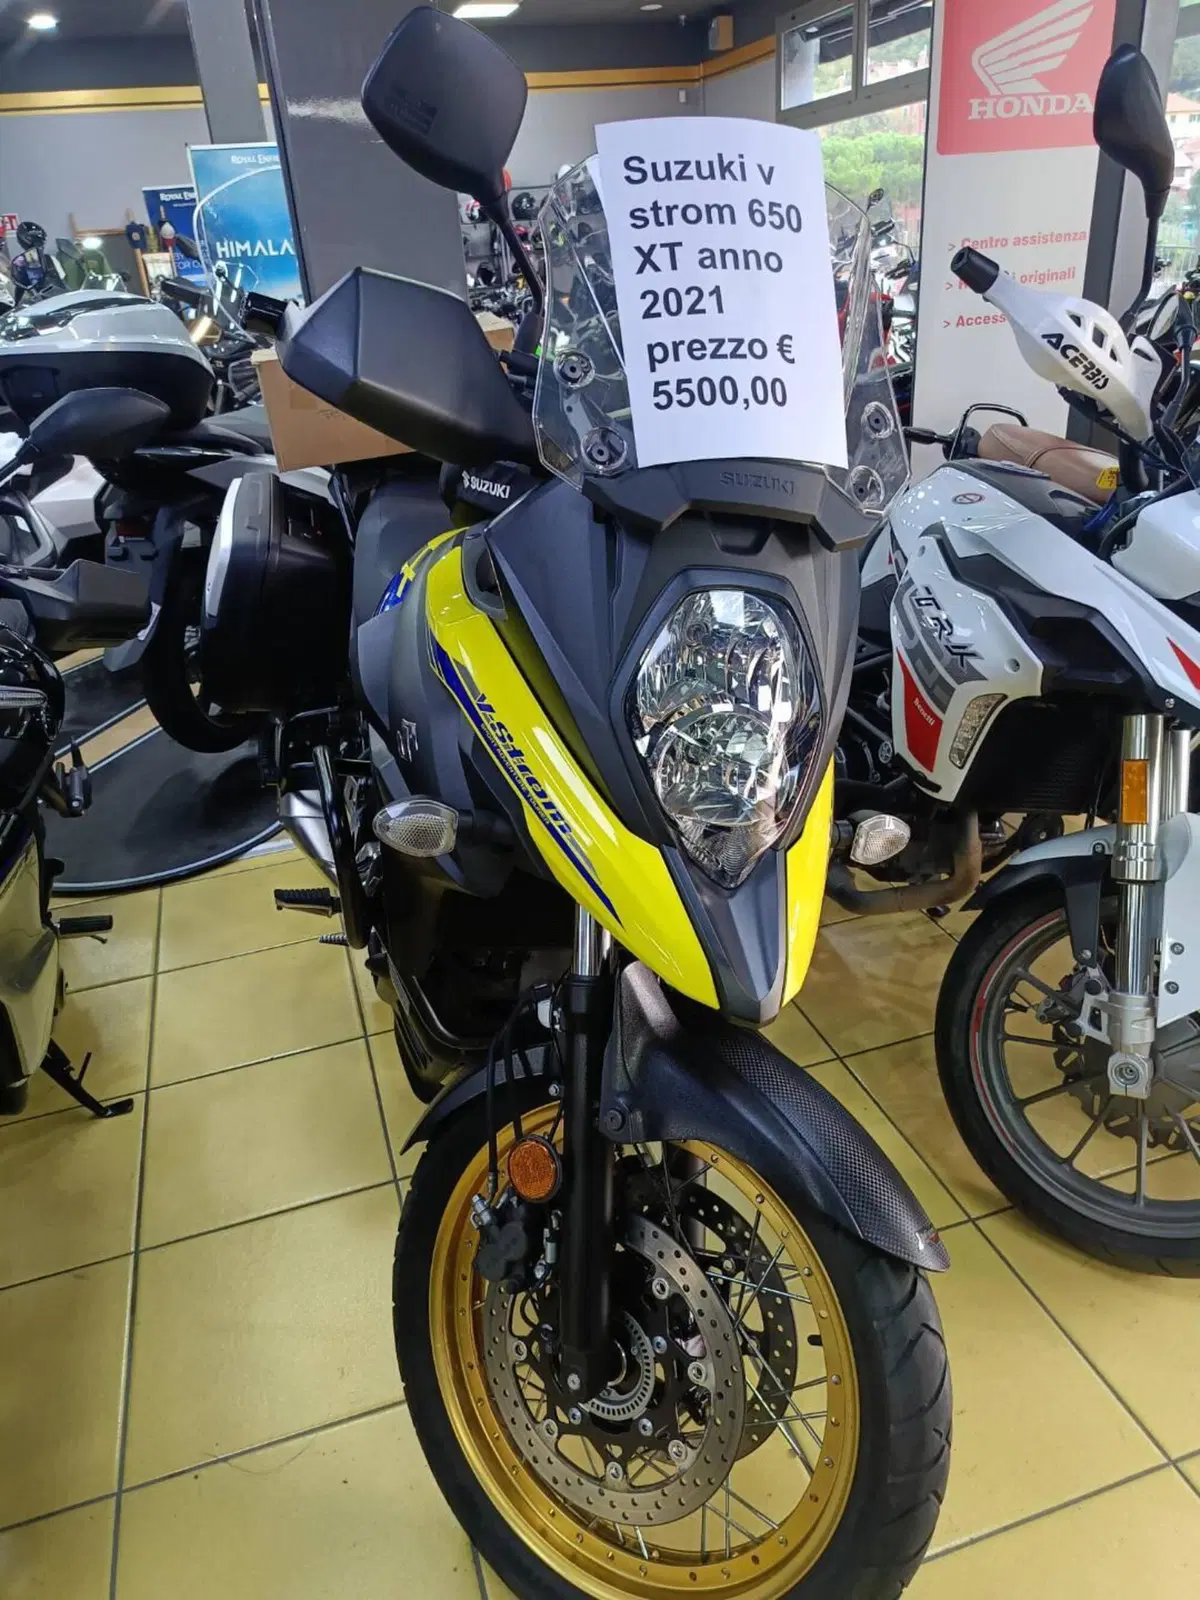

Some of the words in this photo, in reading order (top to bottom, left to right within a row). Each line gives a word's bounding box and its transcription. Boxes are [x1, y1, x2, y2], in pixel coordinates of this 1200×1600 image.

[968, 93, 1093, 120] HONDA
[623, 153, 747, 185] Suzuki
[756, 163, 775, 186] v
[629, 200, 736, 229] strom
[748, 198, 802, 233] 650
[215, 238, 294, 258] HIMALA
[960, 236, 1009, 250] Centro
[1012, 230, 1088, 247] assistenza
[633, 241, 683, 275] XT
[698, 246, 783, 273] anno
[1020, 267, 1076, 285] originali
[640, 285, 724, 319] 2021
[647, 338, 768, 372] prezzo
[776, 334, 795, 364] €
[1041, 333, 1109, 390] ACERBIS
[653, 375, 787, 411] 5500,00
[470, 476, 510, 499] SUZUKI
[720, 471, 794, 496] SUZUKI
[475, 693, 573, 835] V-Strom
